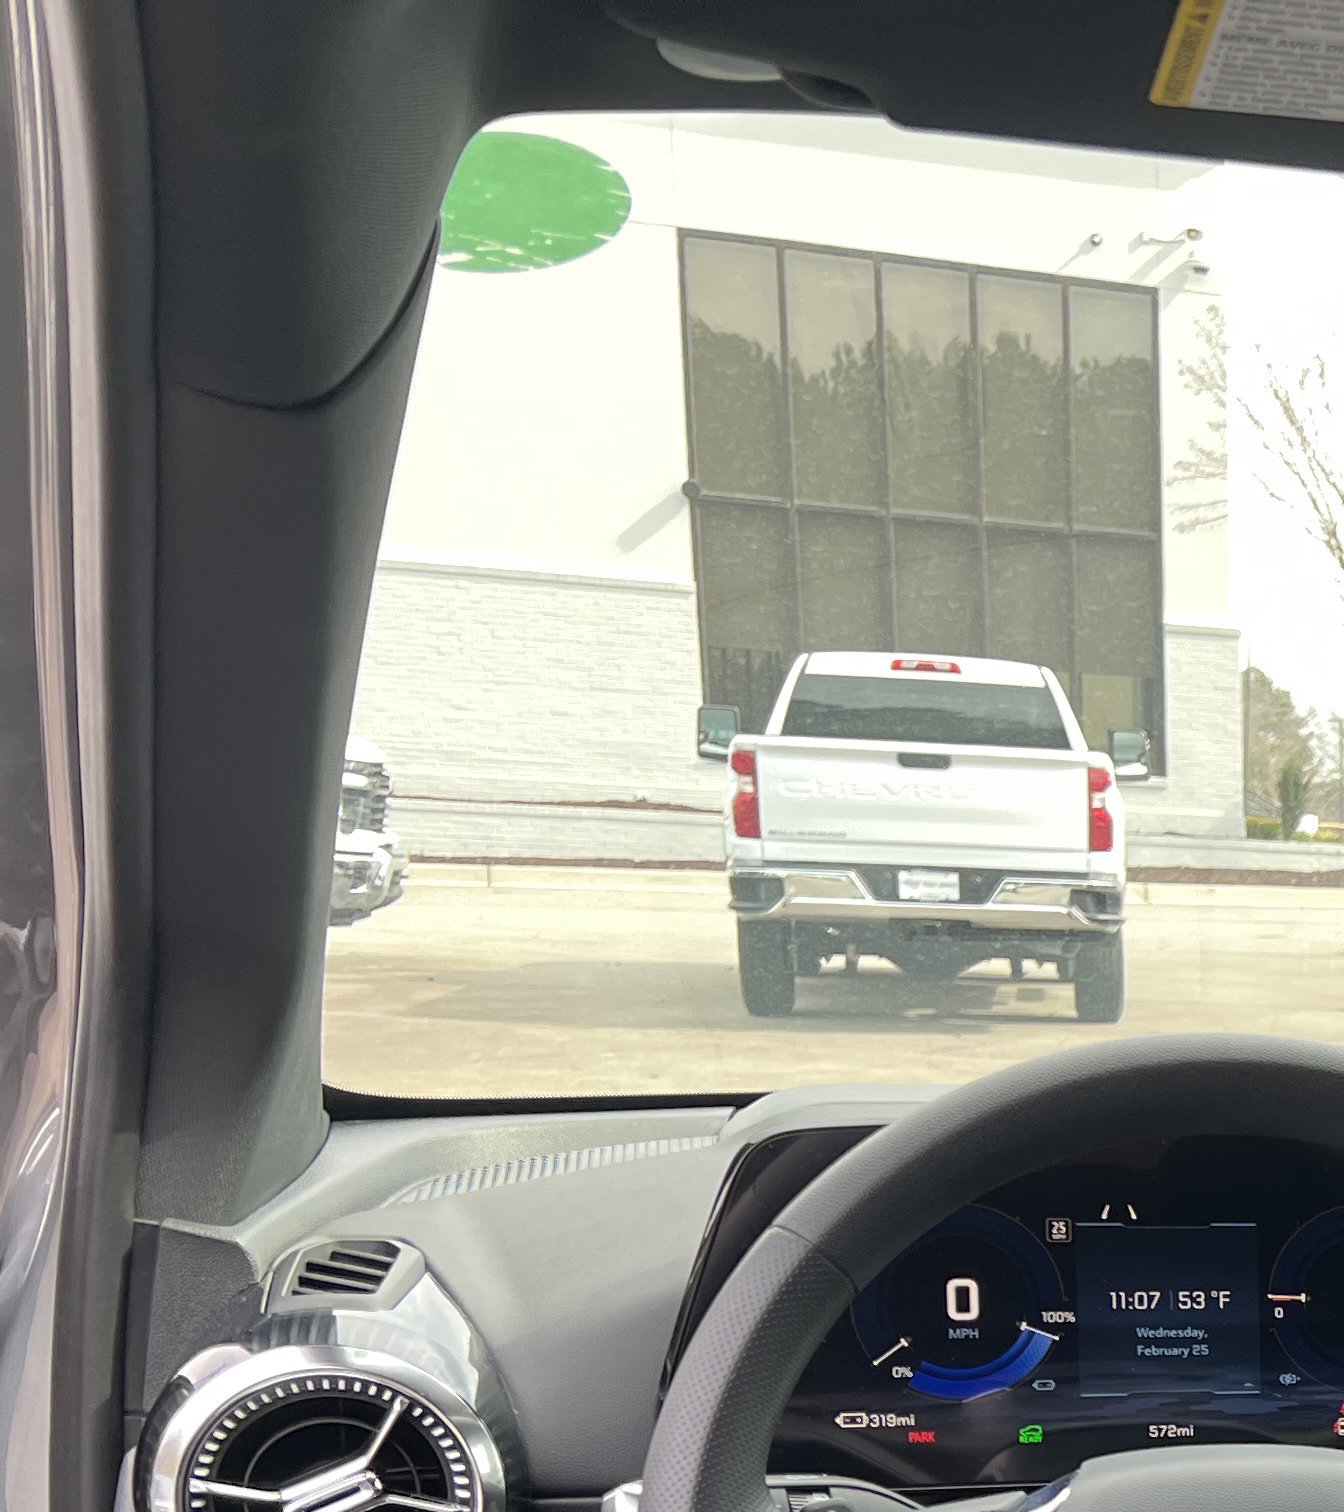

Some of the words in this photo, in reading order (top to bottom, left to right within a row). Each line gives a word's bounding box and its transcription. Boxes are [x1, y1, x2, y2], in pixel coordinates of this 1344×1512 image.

[1051, 1221, 1067, 1234] 25
[945, 1277, 980, 1321] 0
[1108, 1290, 1161, 1310] 11:07
[1042, 1310, 1076, 1324] 100%
[948, 1327, 980, 1340] MPH
[1136, 1344, 1190, 1359] February
[1192, 1344, 1209, 1356] 25
[891, 1366, 914, 1379] 0%
[869, 1413, 916, 1428] 319mi
[907, 1431, 937, 1444] PARK
[1148, 1424, 1195, 1438] 572mi
